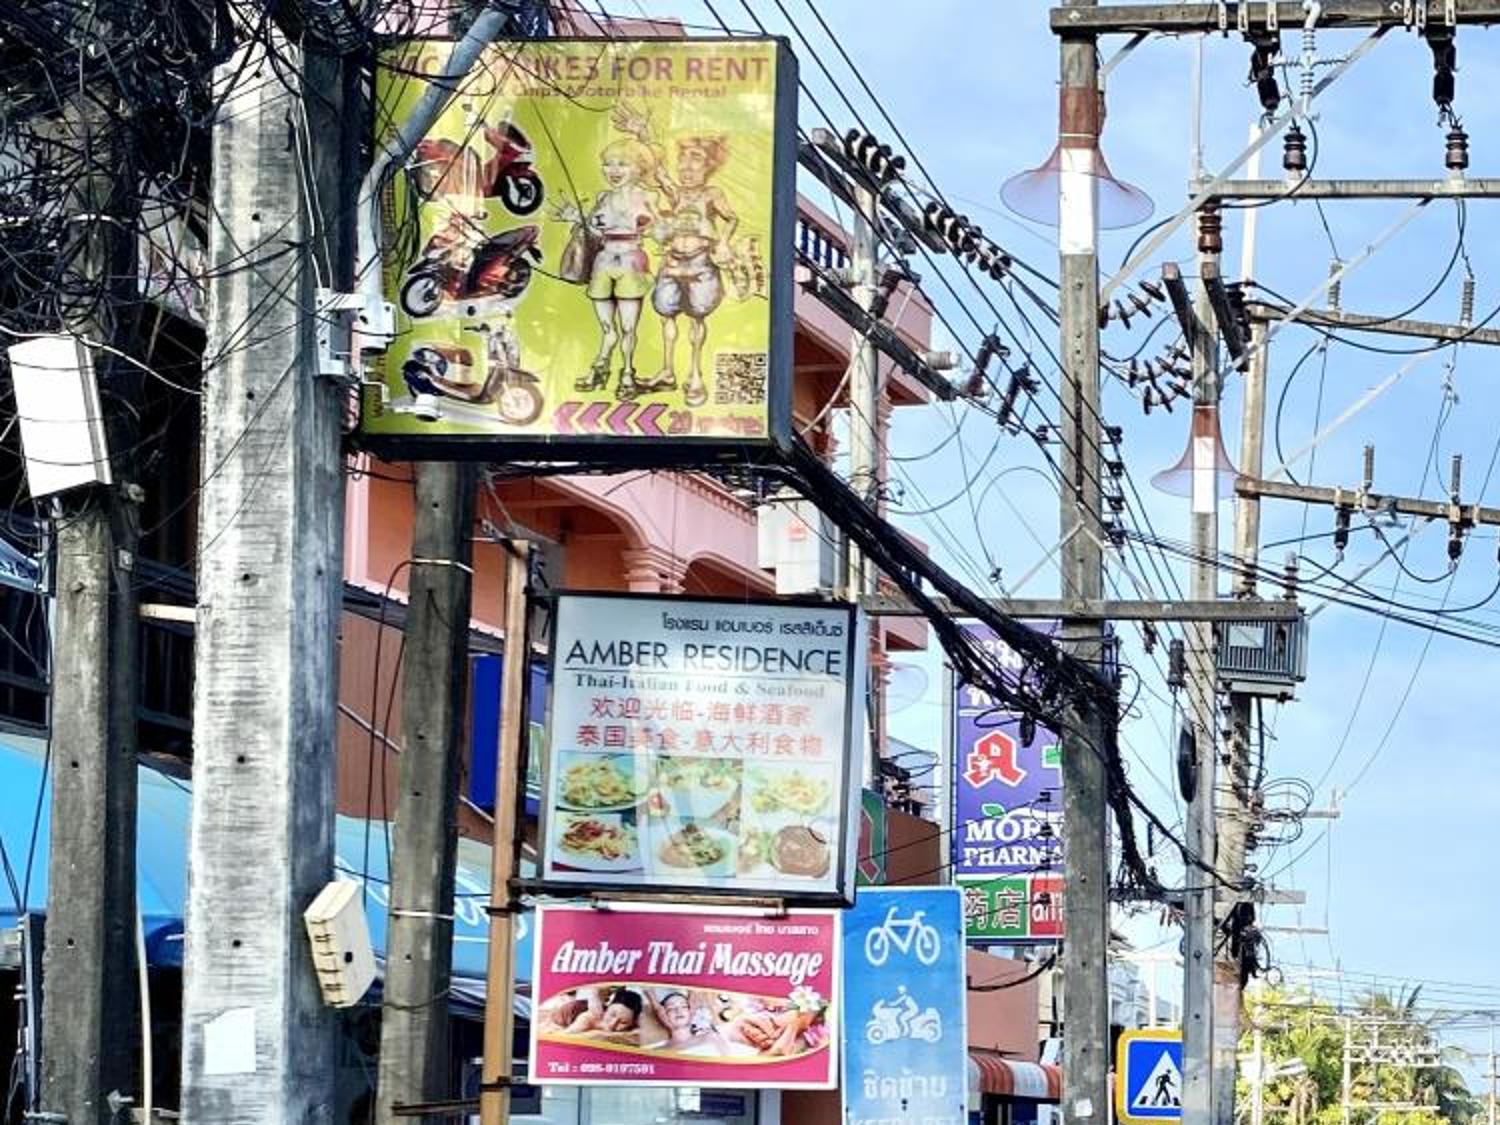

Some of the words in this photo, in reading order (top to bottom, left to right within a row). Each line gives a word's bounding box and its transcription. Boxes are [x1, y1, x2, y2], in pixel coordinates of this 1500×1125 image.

[612, 56, 673, 80] FOR
[685, 56, 768, 80] RENT
[670, 85, 727, 98] Rental
[565, 639, 669, 670] AMBER
[683, 643, 841, 676] RESIDENCE
[575, 672, 679, 692] Thai-Italian
[685, 678, 729, 695] Food
[734, 681, 751, 696] &
[757, 682, 826, 699] Seafood
[551, 940, 642, 974] Amber
[648, 941, 704, 975] Thai
[708, 943, 822, 985] Massage
